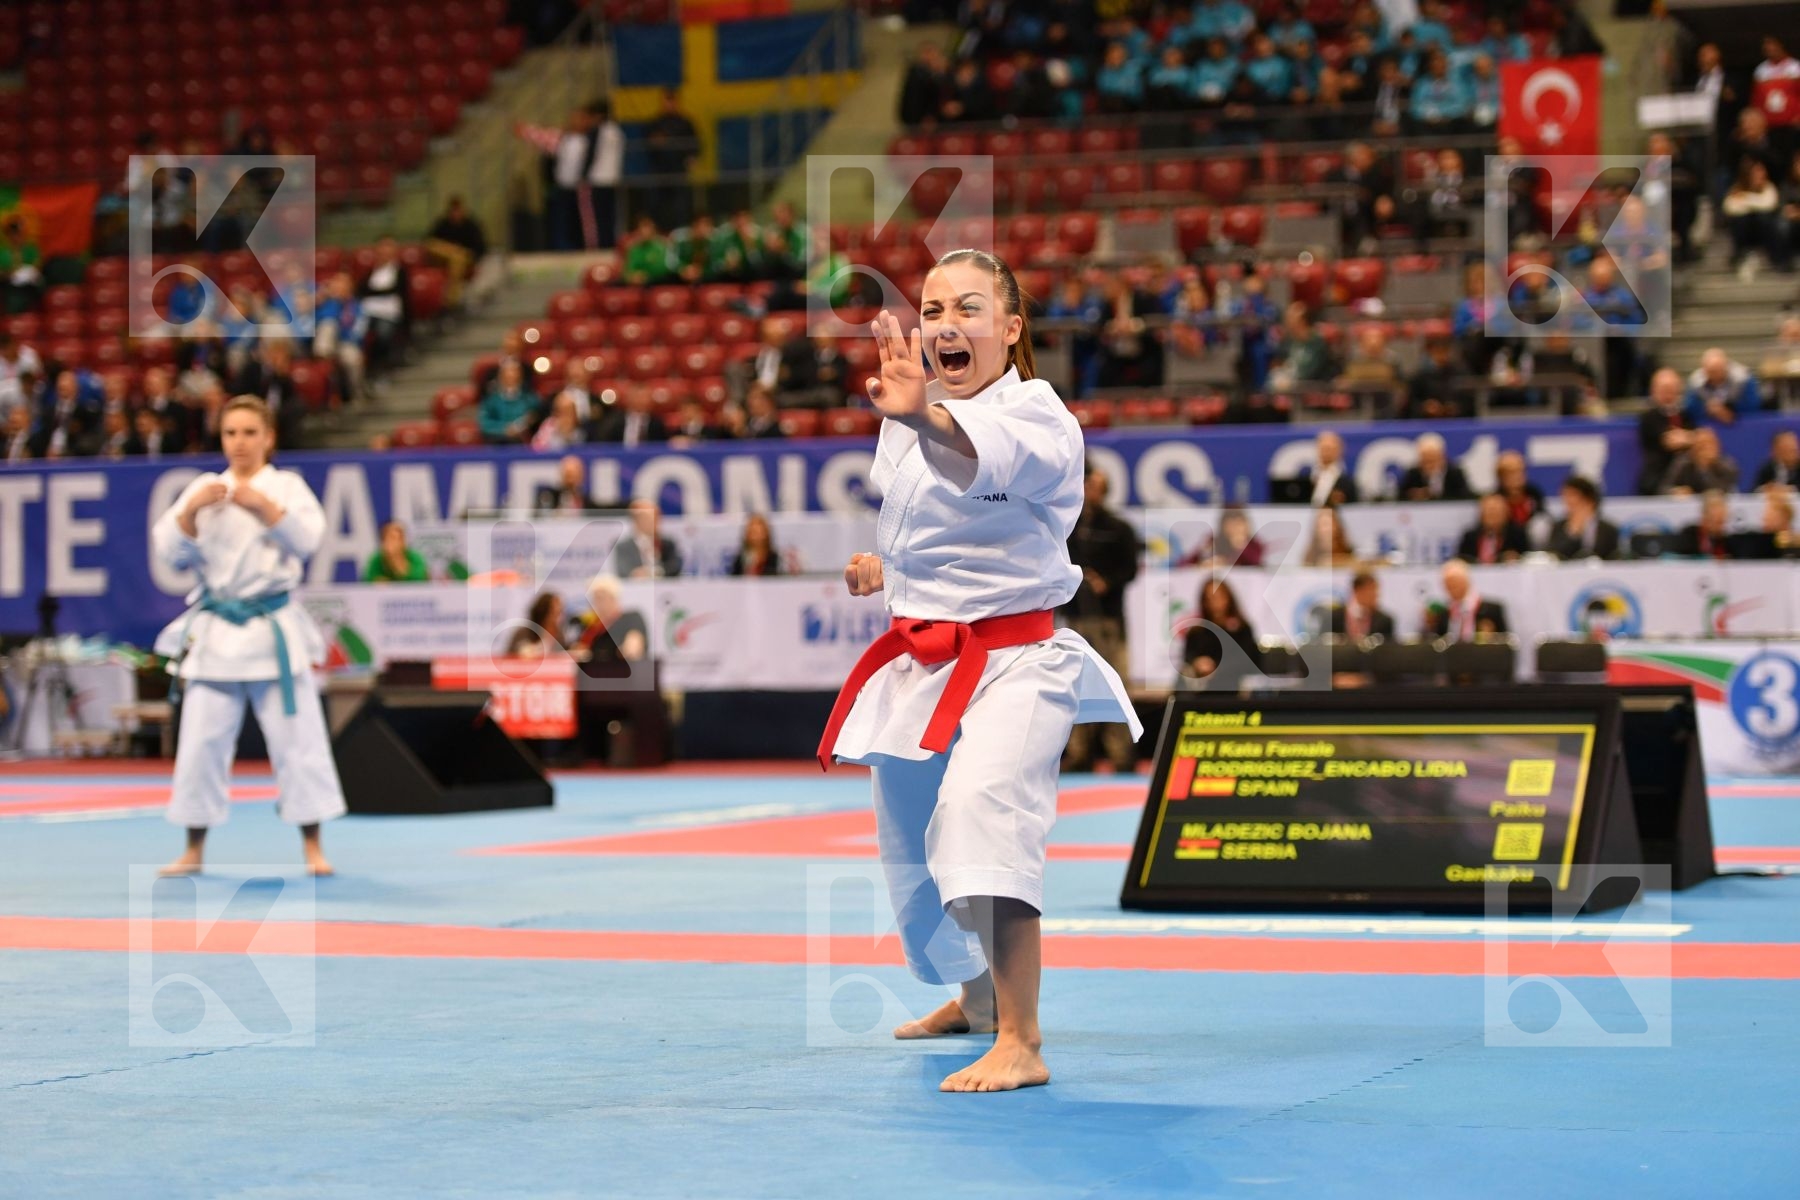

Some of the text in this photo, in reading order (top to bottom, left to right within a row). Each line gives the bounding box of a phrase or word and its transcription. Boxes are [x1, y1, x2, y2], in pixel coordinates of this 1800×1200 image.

[1746, 661, 1799, 737] 3
[1184, 711, 1246, 727] Tatami
[1179, 741, 1335, 758] U21 Kata Female
[1196, 760, 1468, 780] RODRIGUEZ_ENCABO LIDIA
[1236, 780, 1299, 796] SPAIN
[1180, 823, 1372, 840] MLADEZIC BOJANA
[1221, 843, 1297, 861] SERBIA
